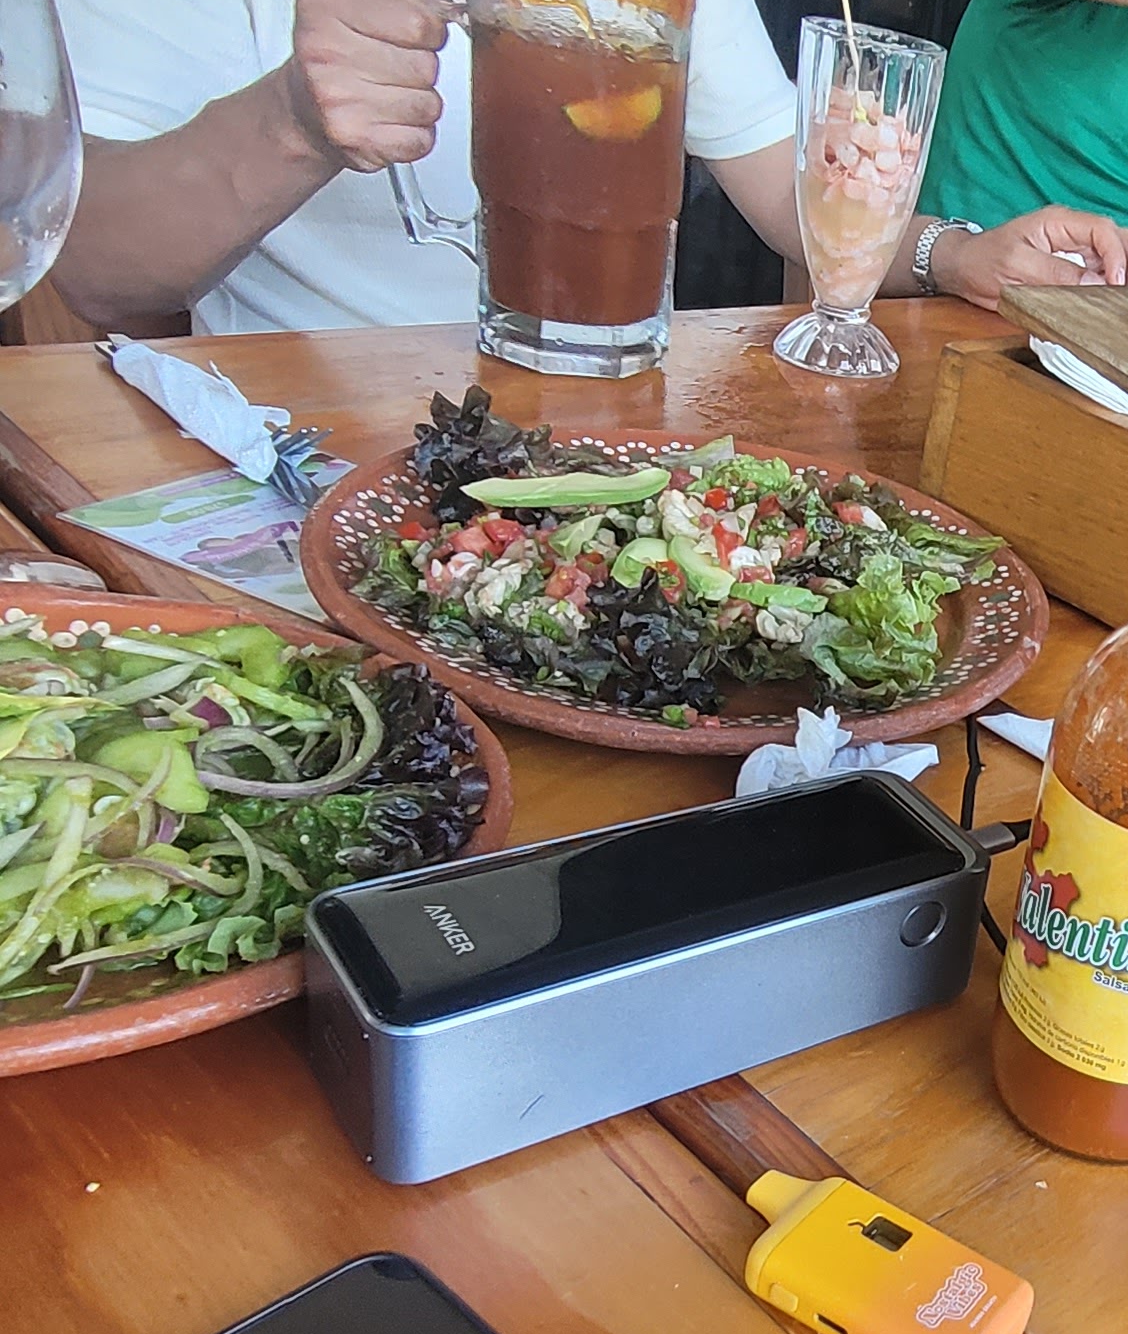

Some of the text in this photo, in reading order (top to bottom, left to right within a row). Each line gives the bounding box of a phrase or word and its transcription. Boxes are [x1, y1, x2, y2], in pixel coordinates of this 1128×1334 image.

[423, 905, 476, 956] ANKER
[921, 1266, 979, 1323] Nostalgic
[945, 1283, 982, 1314] Vibes
